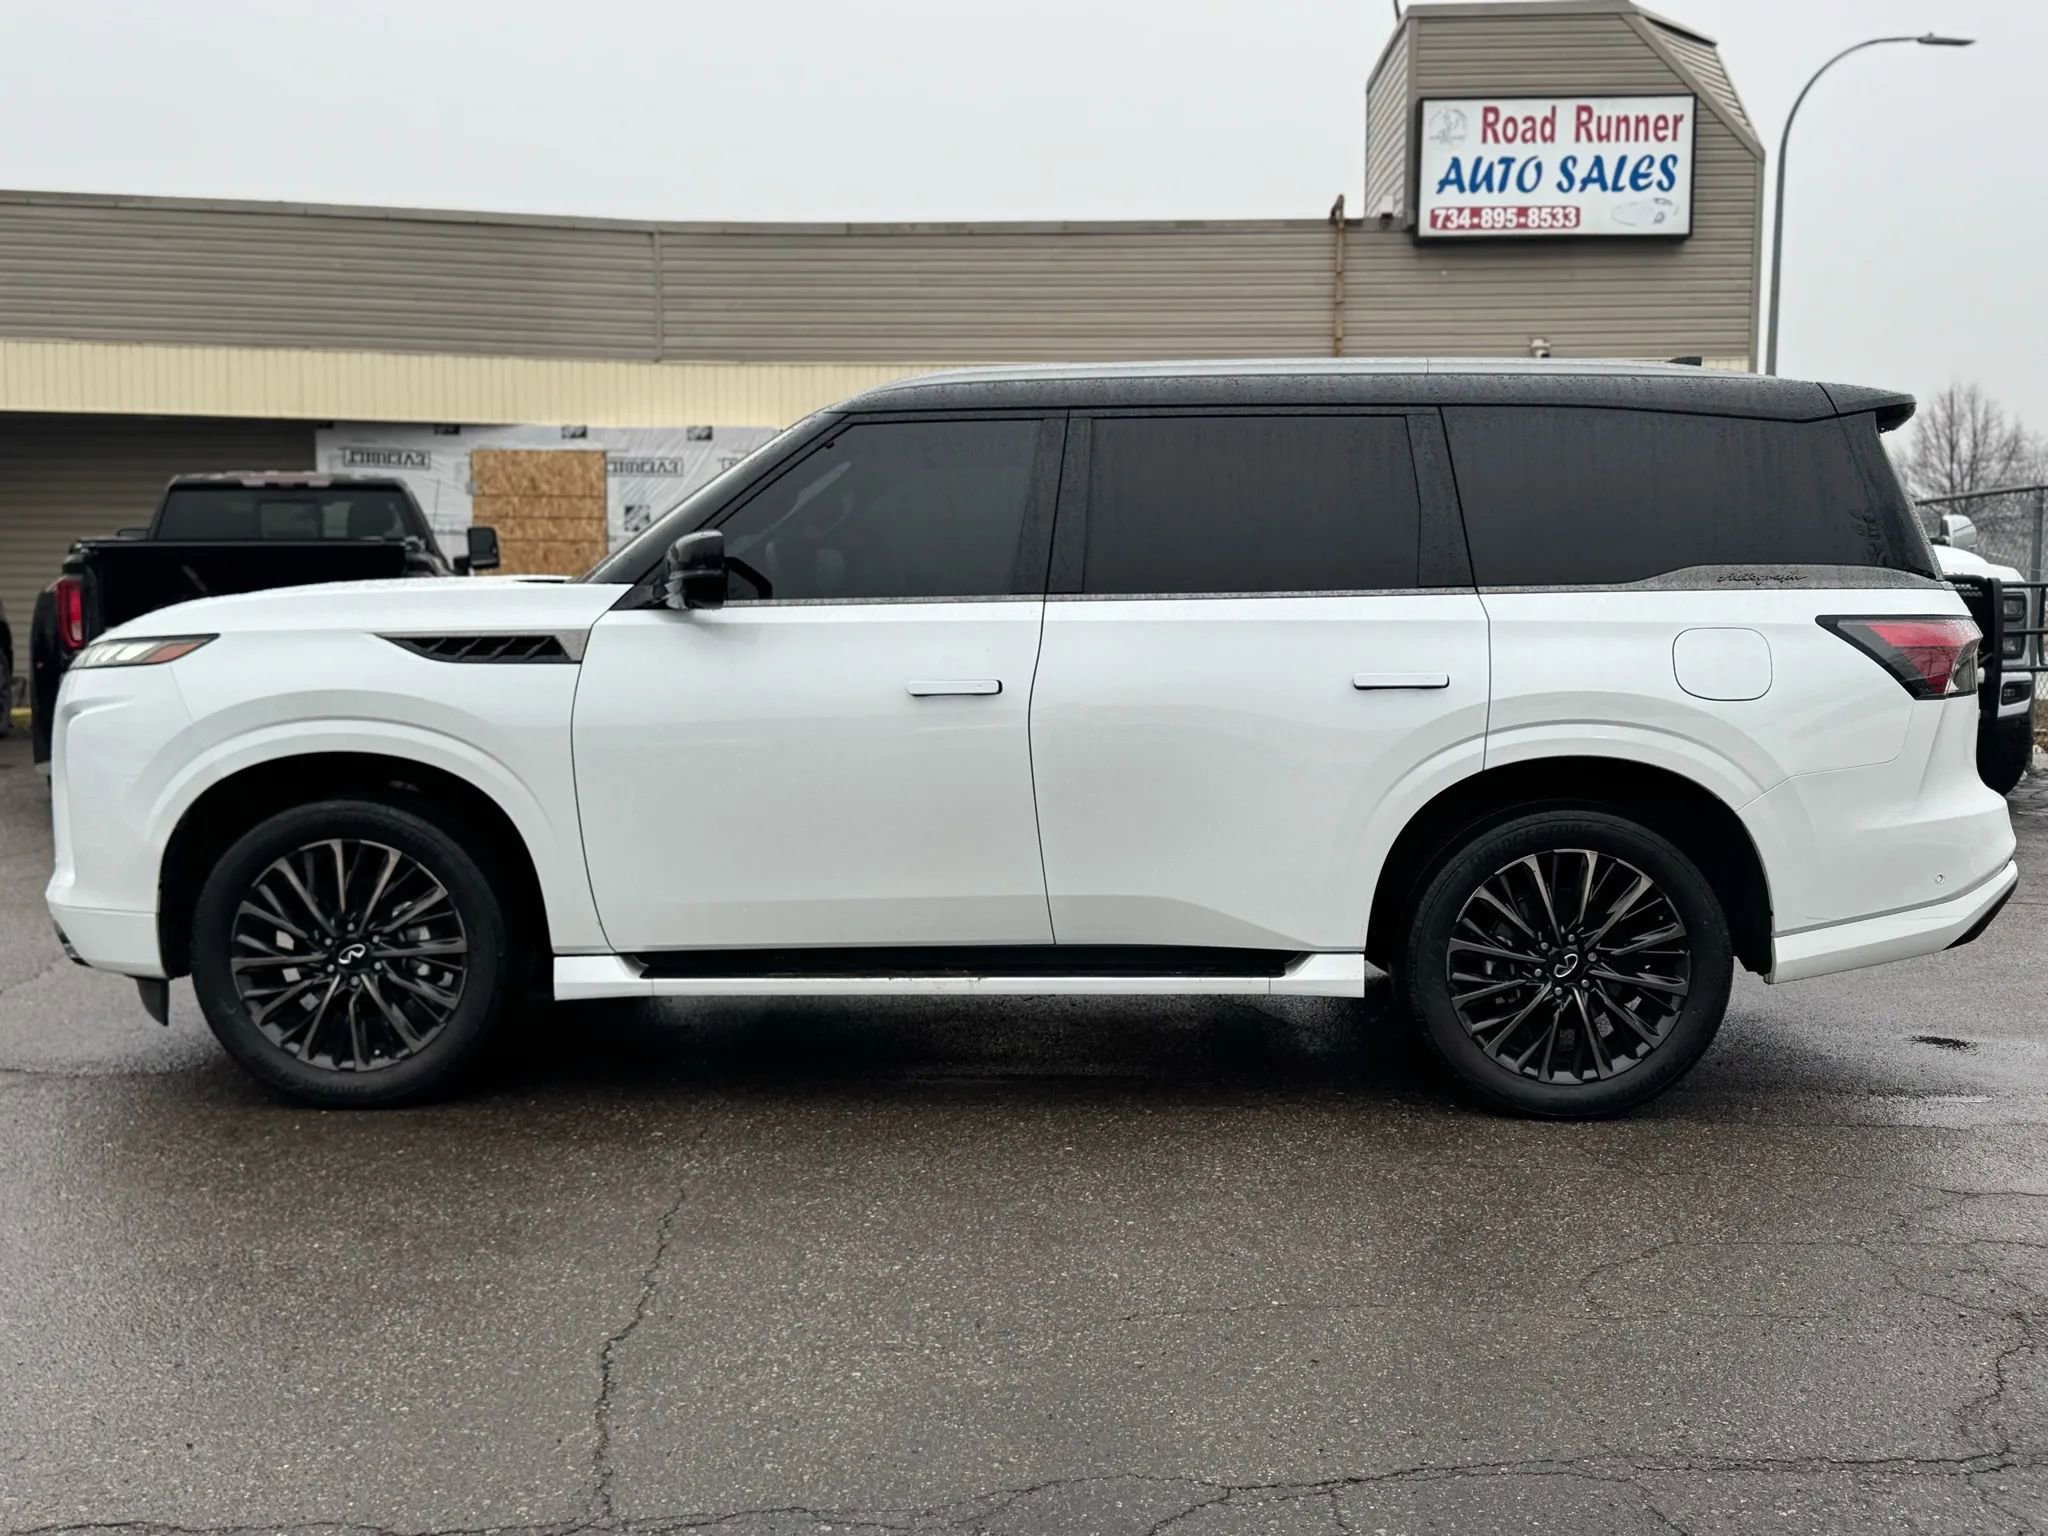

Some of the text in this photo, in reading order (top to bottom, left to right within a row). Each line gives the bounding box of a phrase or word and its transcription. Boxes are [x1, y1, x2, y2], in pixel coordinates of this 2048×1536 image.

[1481, 105, 1685, 144] Road Runner
[1436, 153, 1679, 194] AUTO SALES
[1433, 208, 1577, 229] 734-895-8533
